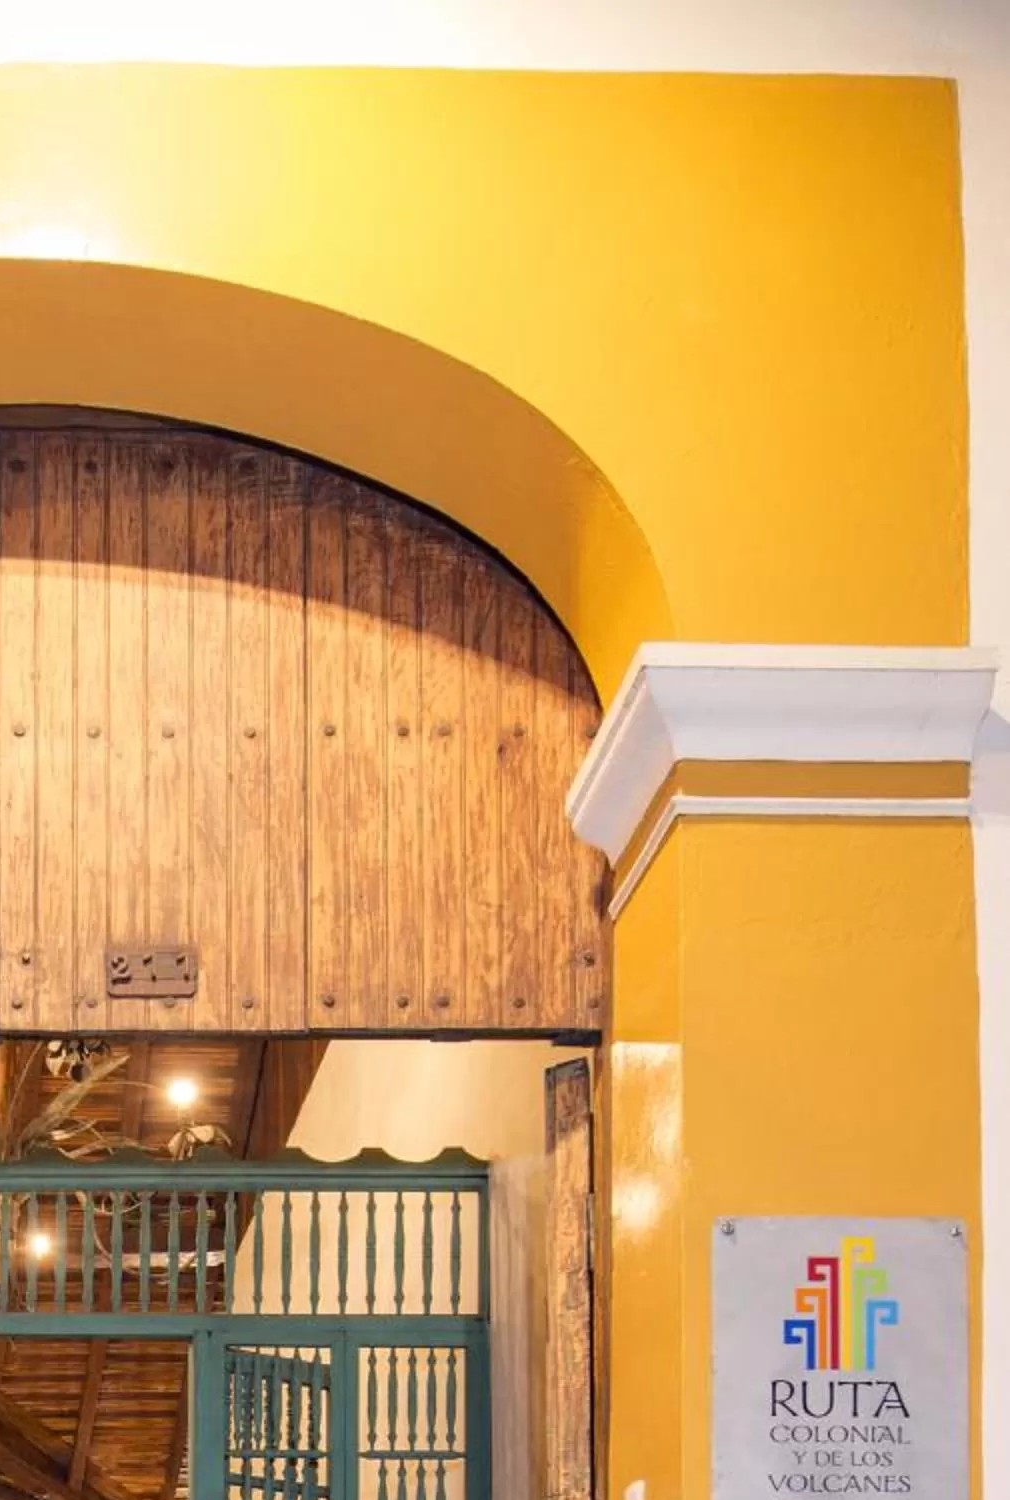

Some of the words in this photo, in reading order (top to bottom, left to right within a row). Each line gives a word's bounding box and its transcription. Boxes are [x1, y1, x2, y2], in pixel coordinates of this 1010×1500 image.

[771, 1379, 910, 1418] RUTA
[769, 1424, 912, 1445] COLONIAL
[793, 1450, 807, 1465] Y
[815, 1451, 843, 1467] DE
[851, 1451, 894, 1467] LOS
[768, 1473, 911, 1493] VOLCANES
